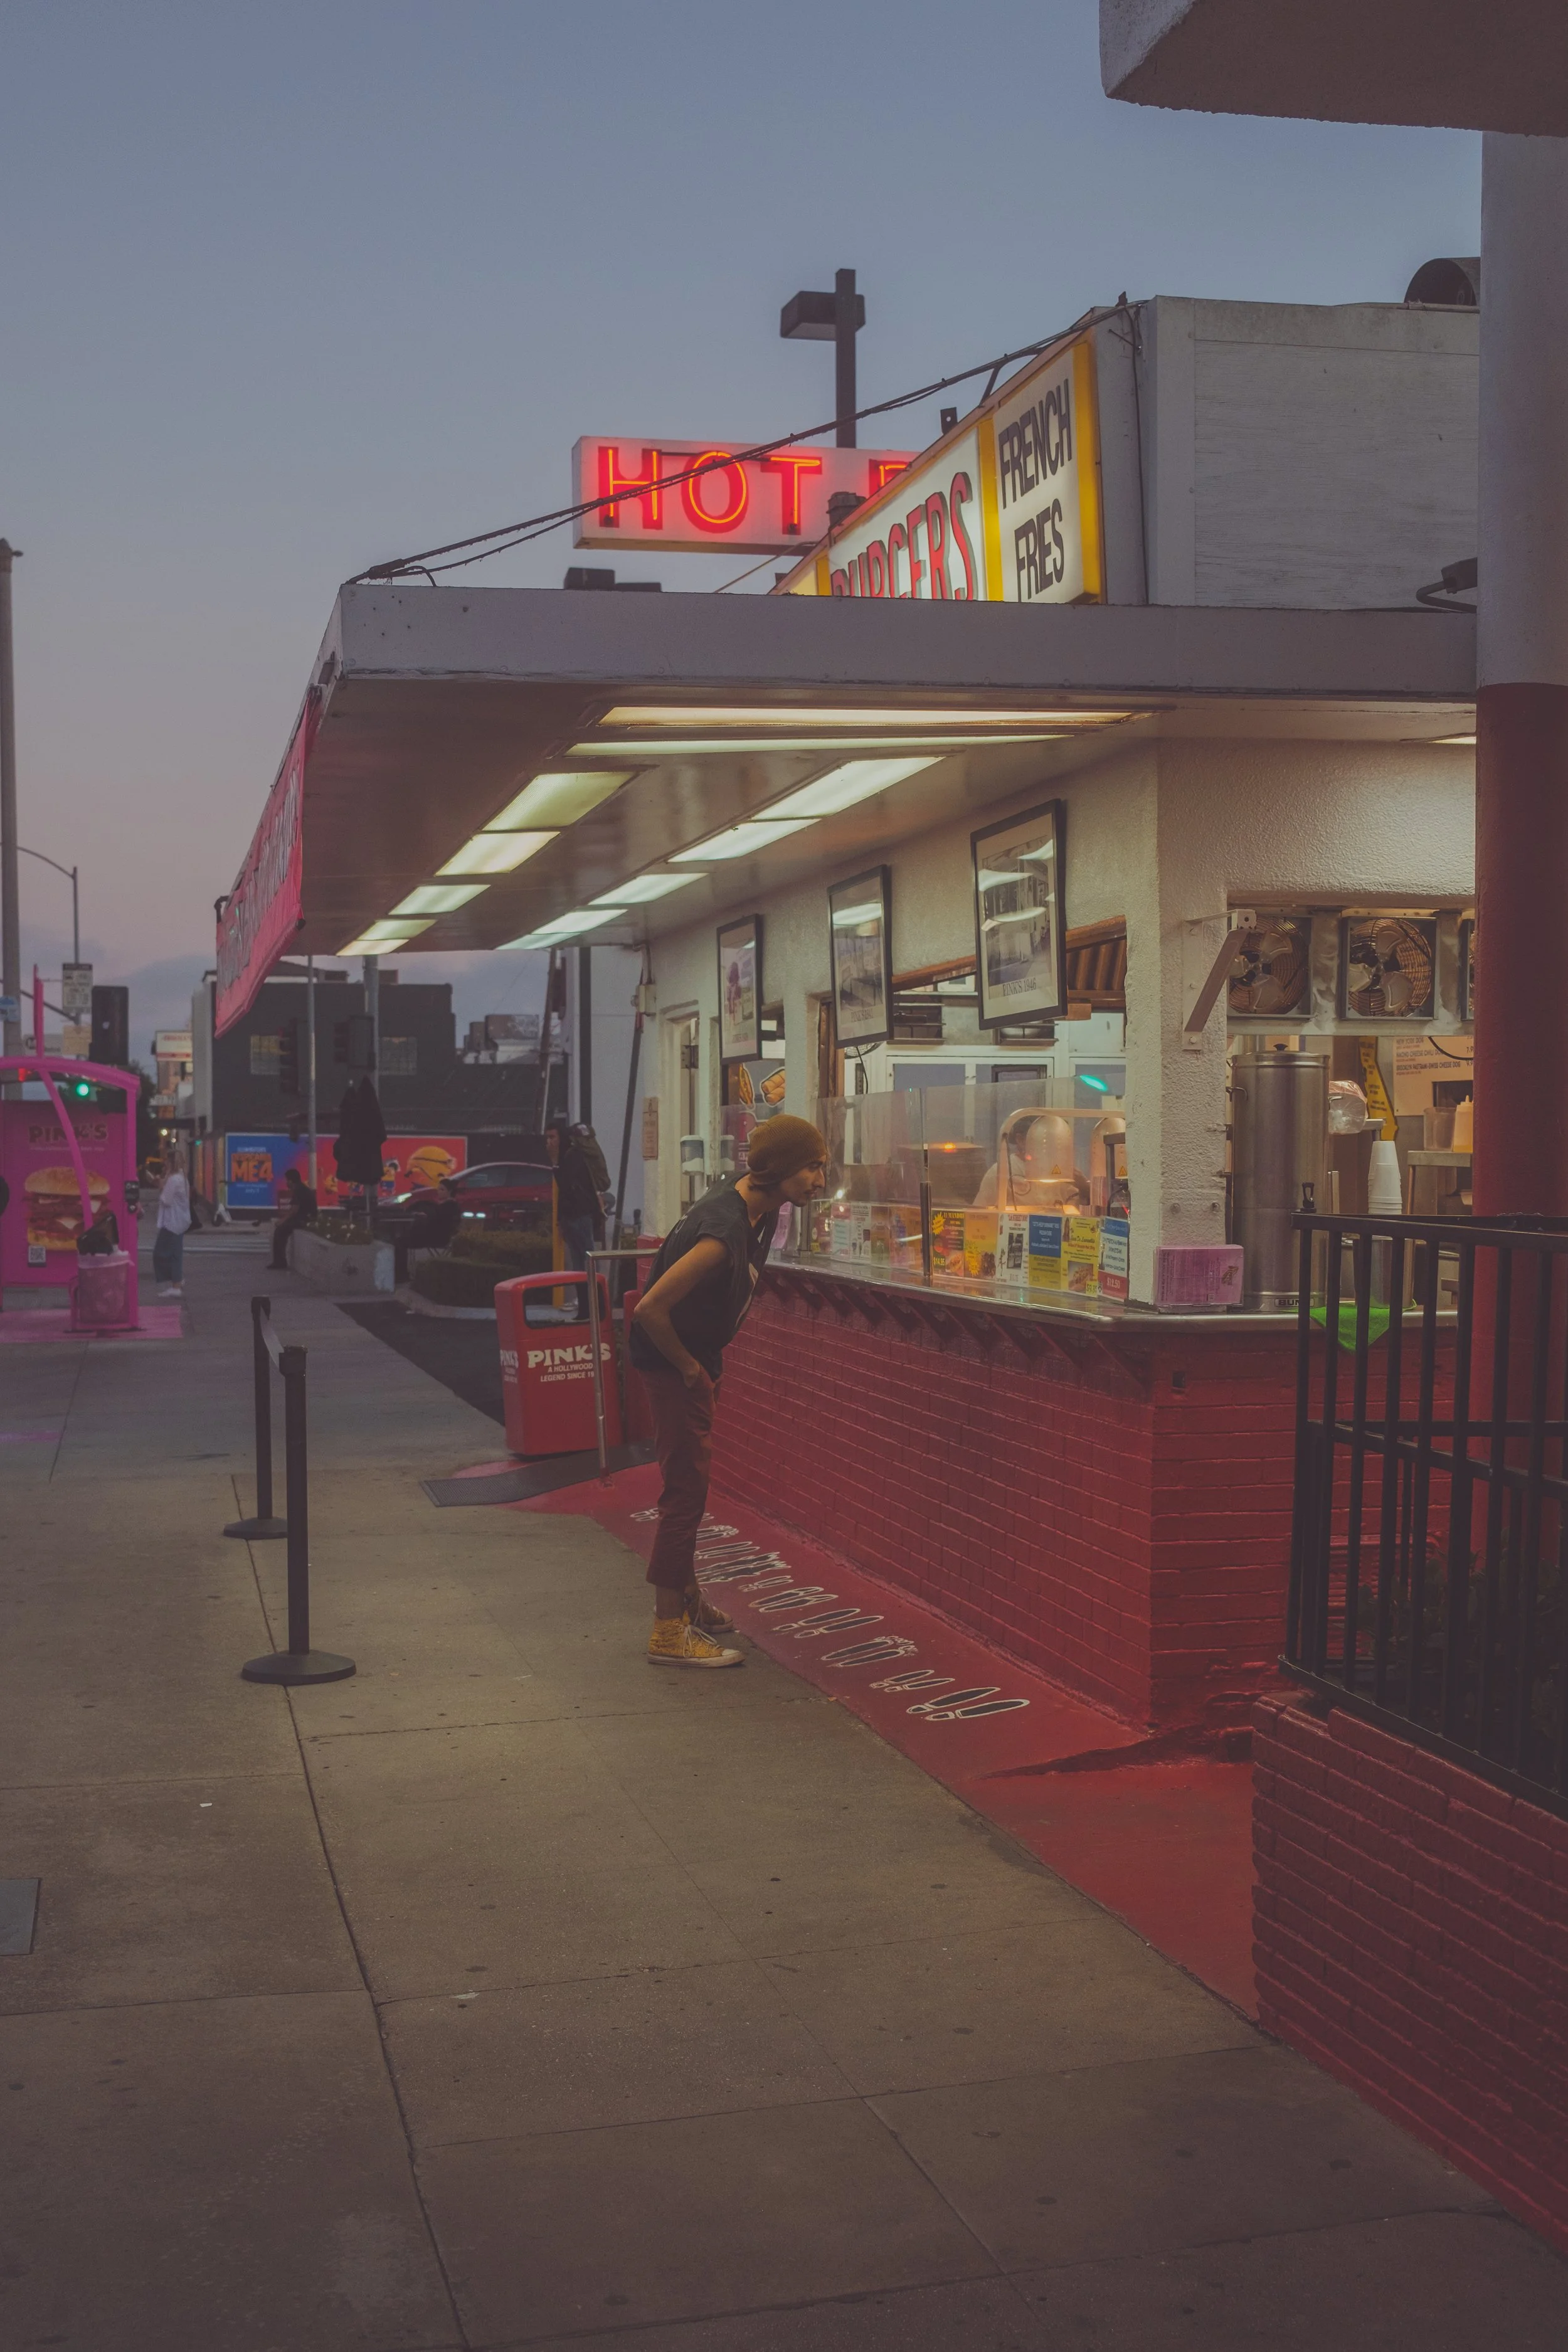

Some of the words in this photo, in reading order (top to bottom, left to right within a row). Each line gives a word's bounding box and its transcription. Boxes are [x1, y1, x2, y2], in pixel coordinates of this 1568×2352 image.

[999, 379, 1072, 509] FRENCH
[598, 446, 823, 536] HOT
[1014, 498, 1065, 602] FRIES
[1003, 980, 1022, 997] PINK'S
[1024, 977, 1037, 992] 1946
[29, 1124, 108, 1143] PINK'S
[1106, 1277, 1120, 1288] $12.50
[527, 1342, 612, 1369] PINK'S
[541, 1373, 566, 1382] LEGEND
[567, 1372, 586, 1380] SINCE
[553, 1362, 593, 1372] HOLLYWOOD
